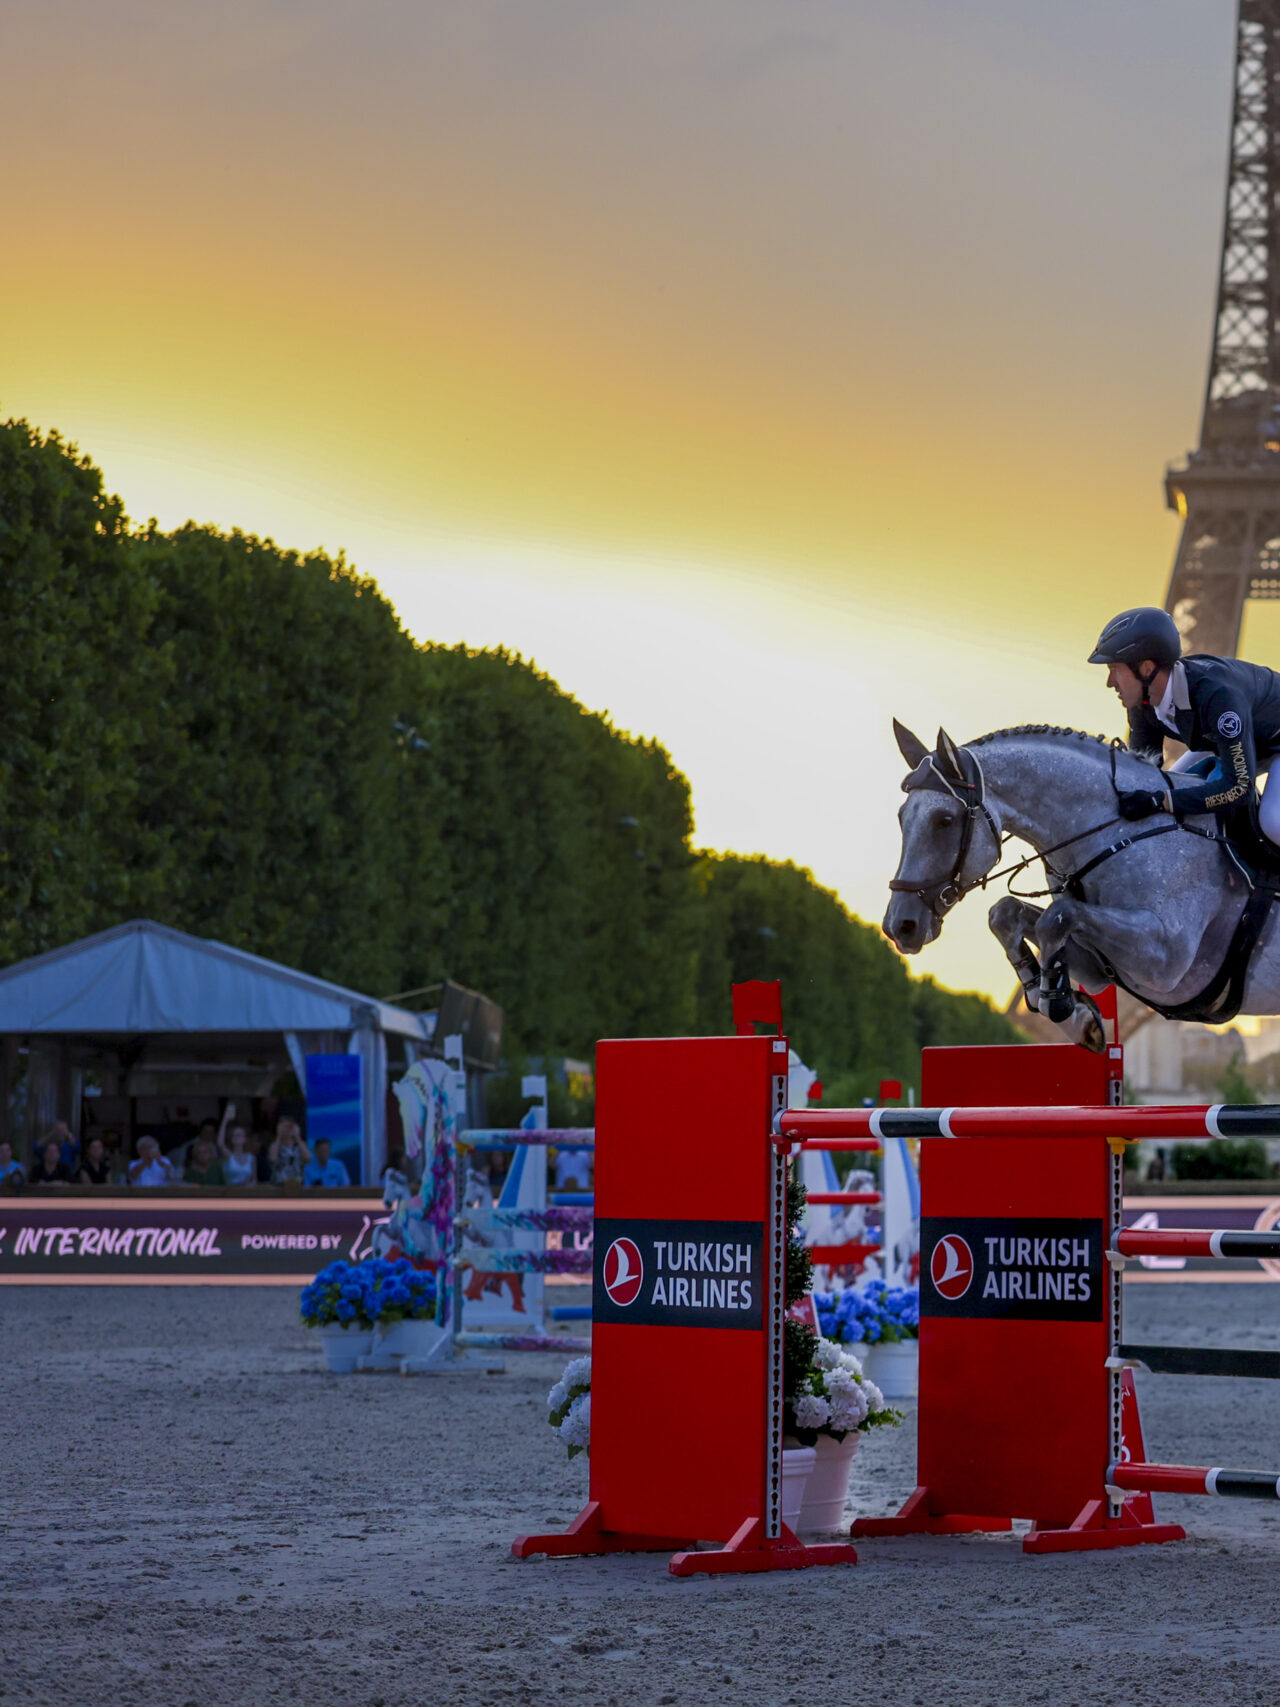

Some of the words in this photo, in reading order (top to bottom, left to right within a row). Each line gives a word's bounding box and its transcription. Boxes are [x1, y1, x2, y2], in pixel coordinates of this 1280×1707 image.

[14, 1227, 222, 1256] INTERNATIONAL
[241, 1234, 318, 1250] POWERED
[321, 1234, 343, 1250] BY
[653, 1241, 752, 1274] TURKISH
[984, 1237, 1090, 1267] TURKISH
[651, 1276, 753, 1310] AIRLINES
[982, 1270, 1091, 1302] AIRLINES
